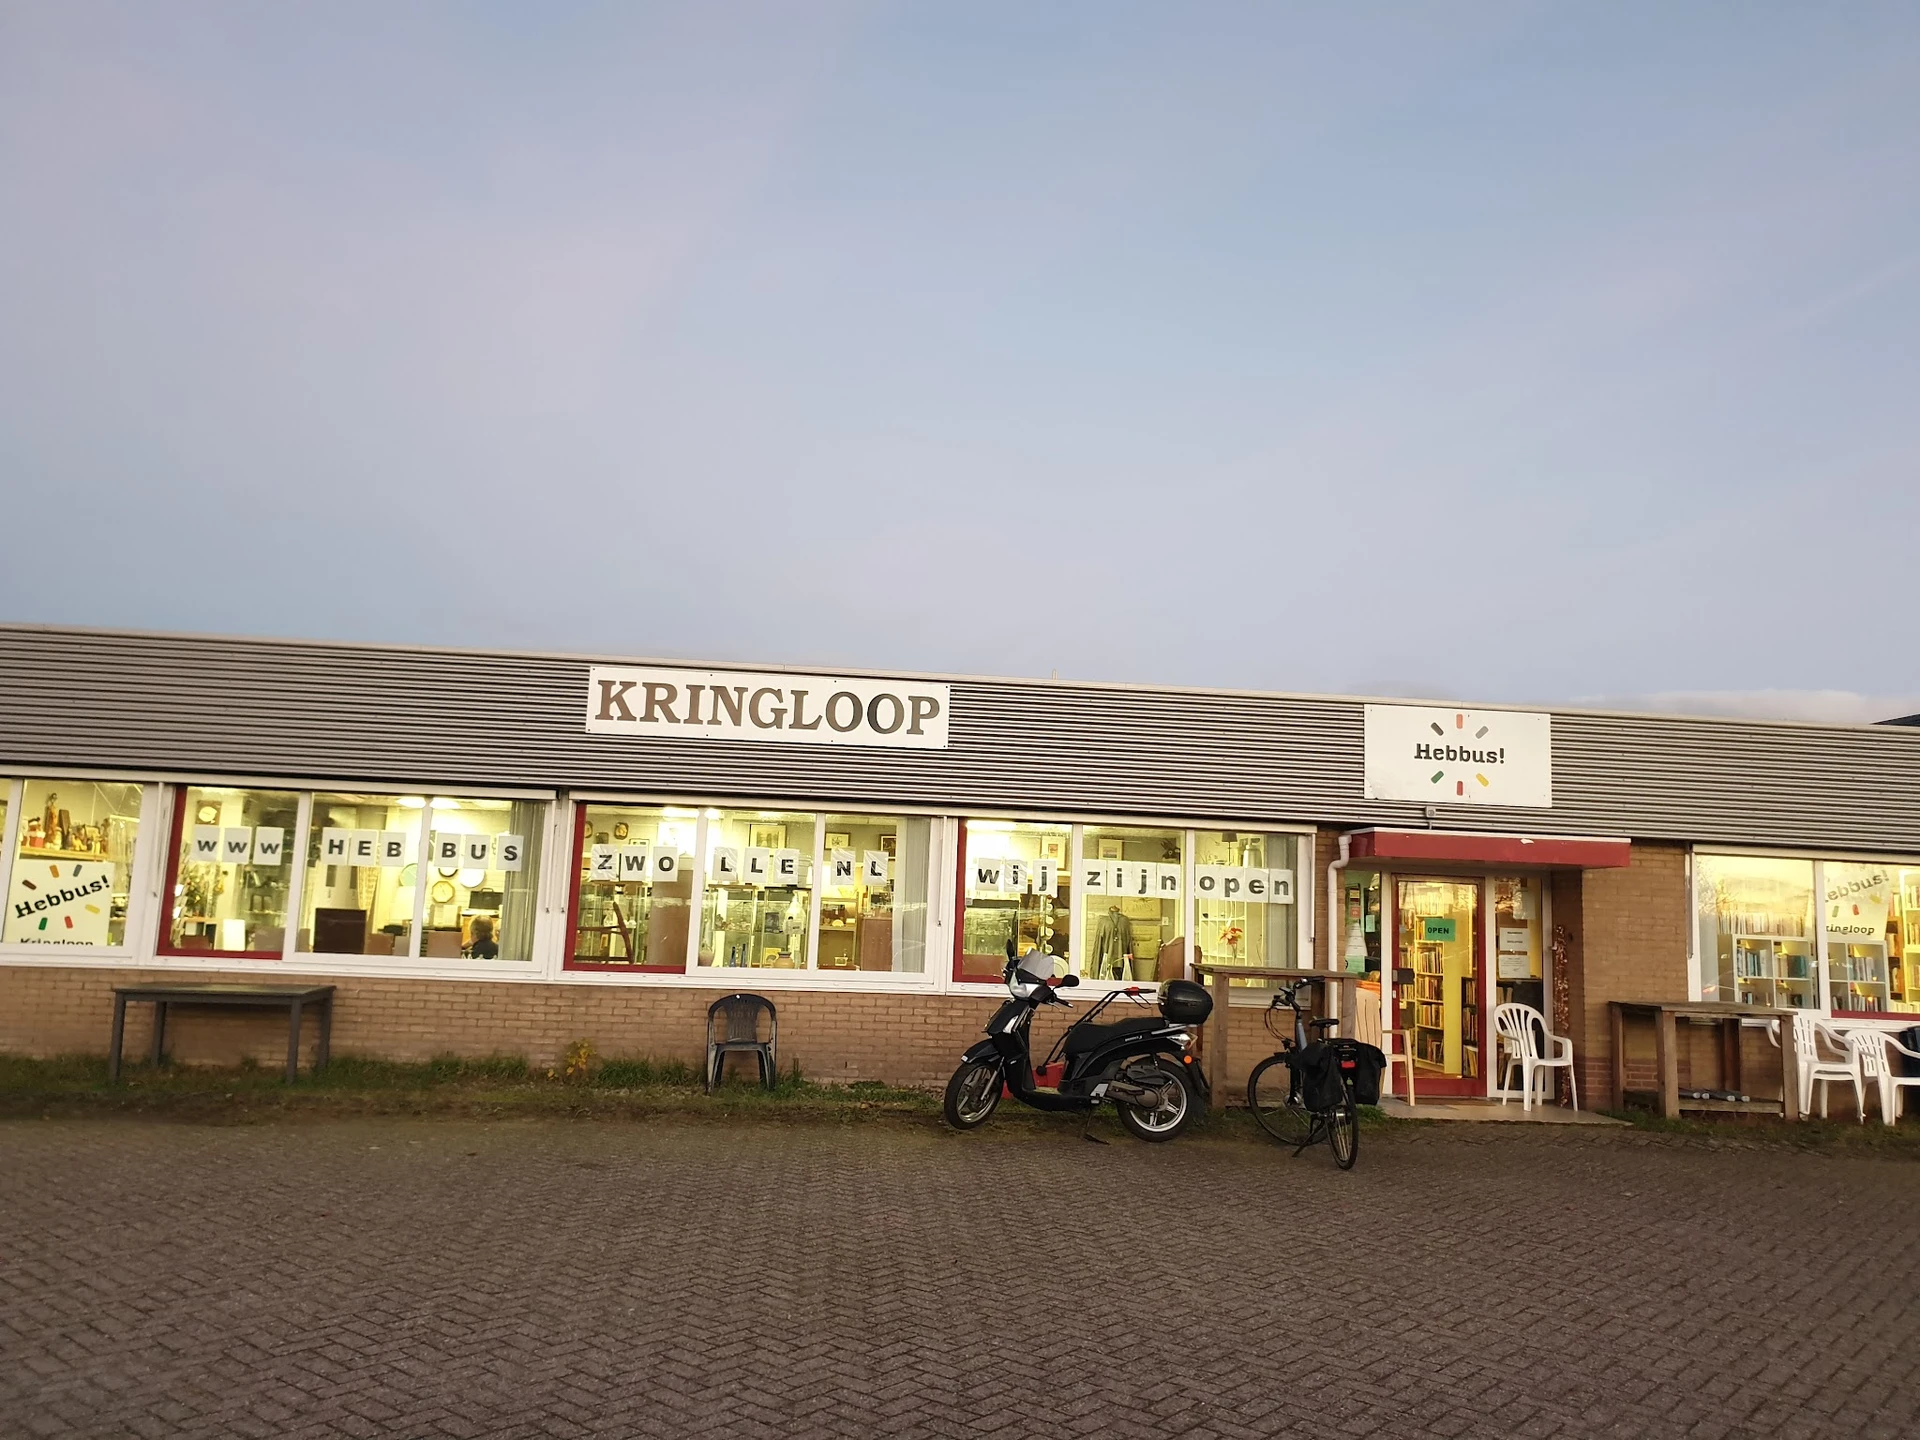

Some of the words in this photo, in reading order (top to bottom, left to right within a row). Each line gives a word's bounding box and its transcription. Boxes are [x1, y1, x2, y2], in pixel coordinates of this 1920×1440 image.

[594, 680, 940, 736] KRINGLOOP
[1413, 743, 1506, 765] Hebbus!
[977, 864, 1048, 892] wij
[1086, 868, 1177, 894] zijn
[1199, 873, 1289, 896] open
[1825, 869, 1890, 903] ebbus!
[15, 874, 110, 919] Hebbus!
[1427, 926, 1450, 934] OPEN
[1825, 924, 1875, 935] ringloop
